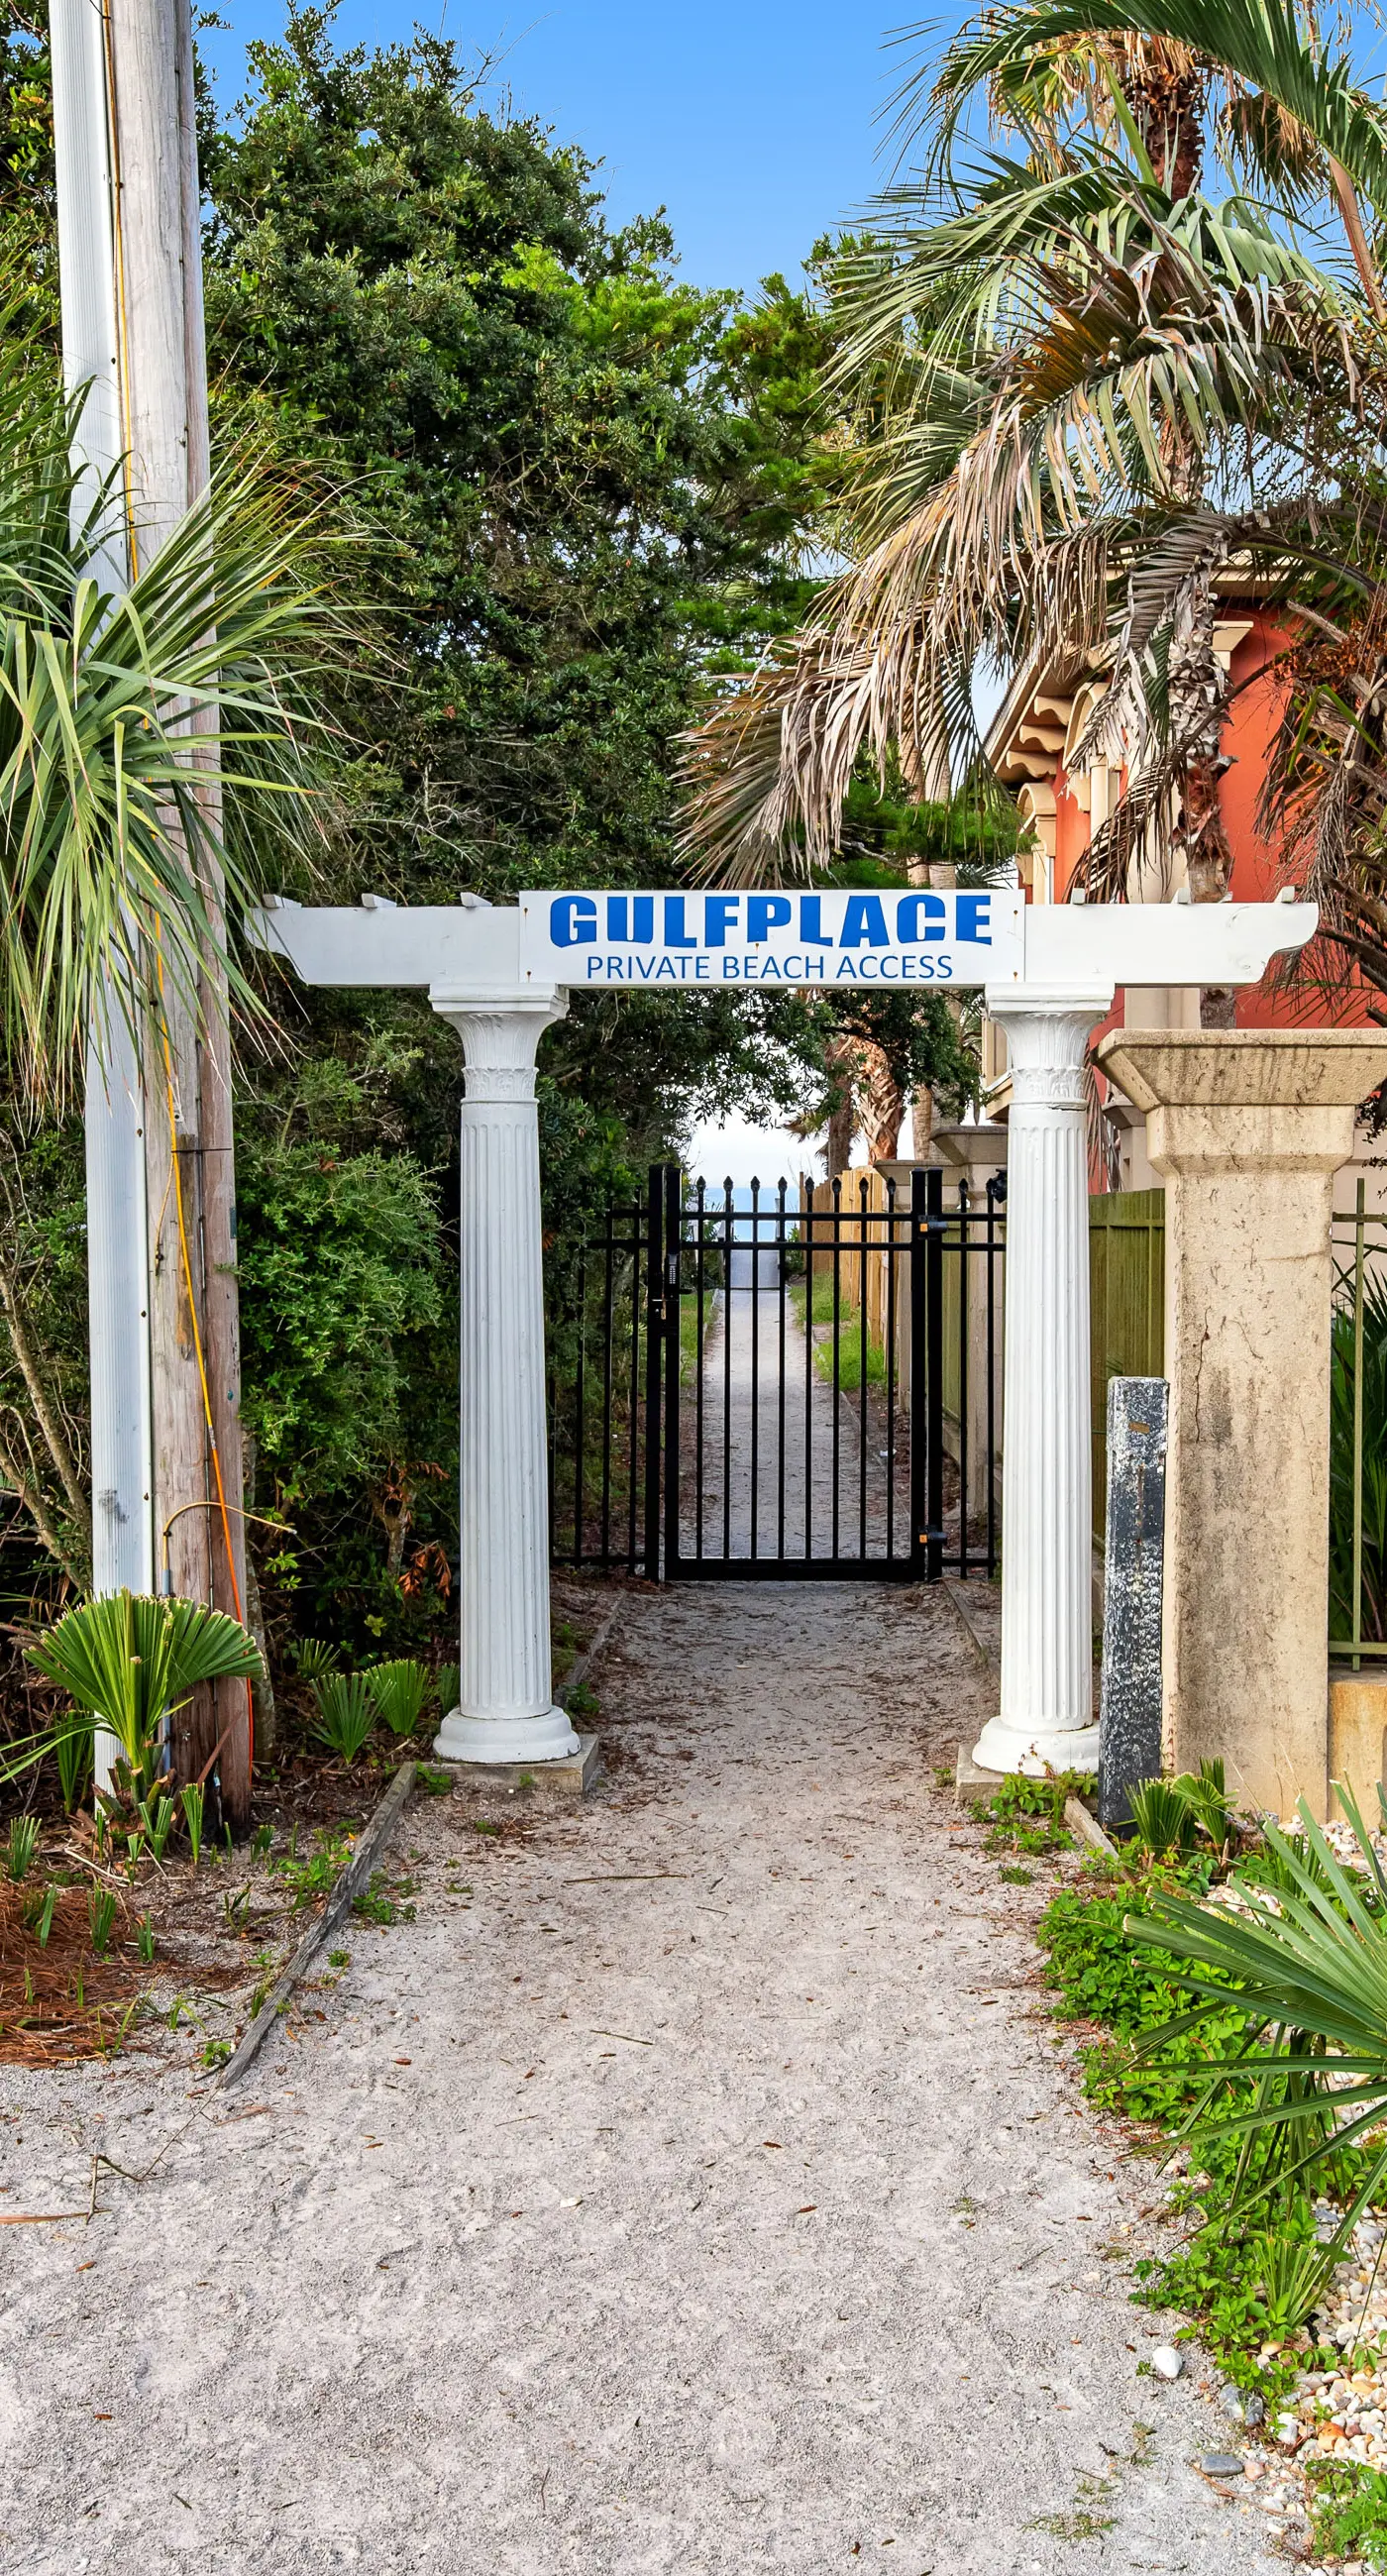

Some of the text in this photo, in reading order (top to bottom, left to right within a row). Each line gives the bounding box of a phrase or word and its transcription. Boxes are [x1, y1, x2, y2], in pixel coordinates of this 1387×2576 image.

[550, 895, 992, 947] GULFPLACE
[587, 955, 953, 979] PRIVATE BEACH ACCESS
